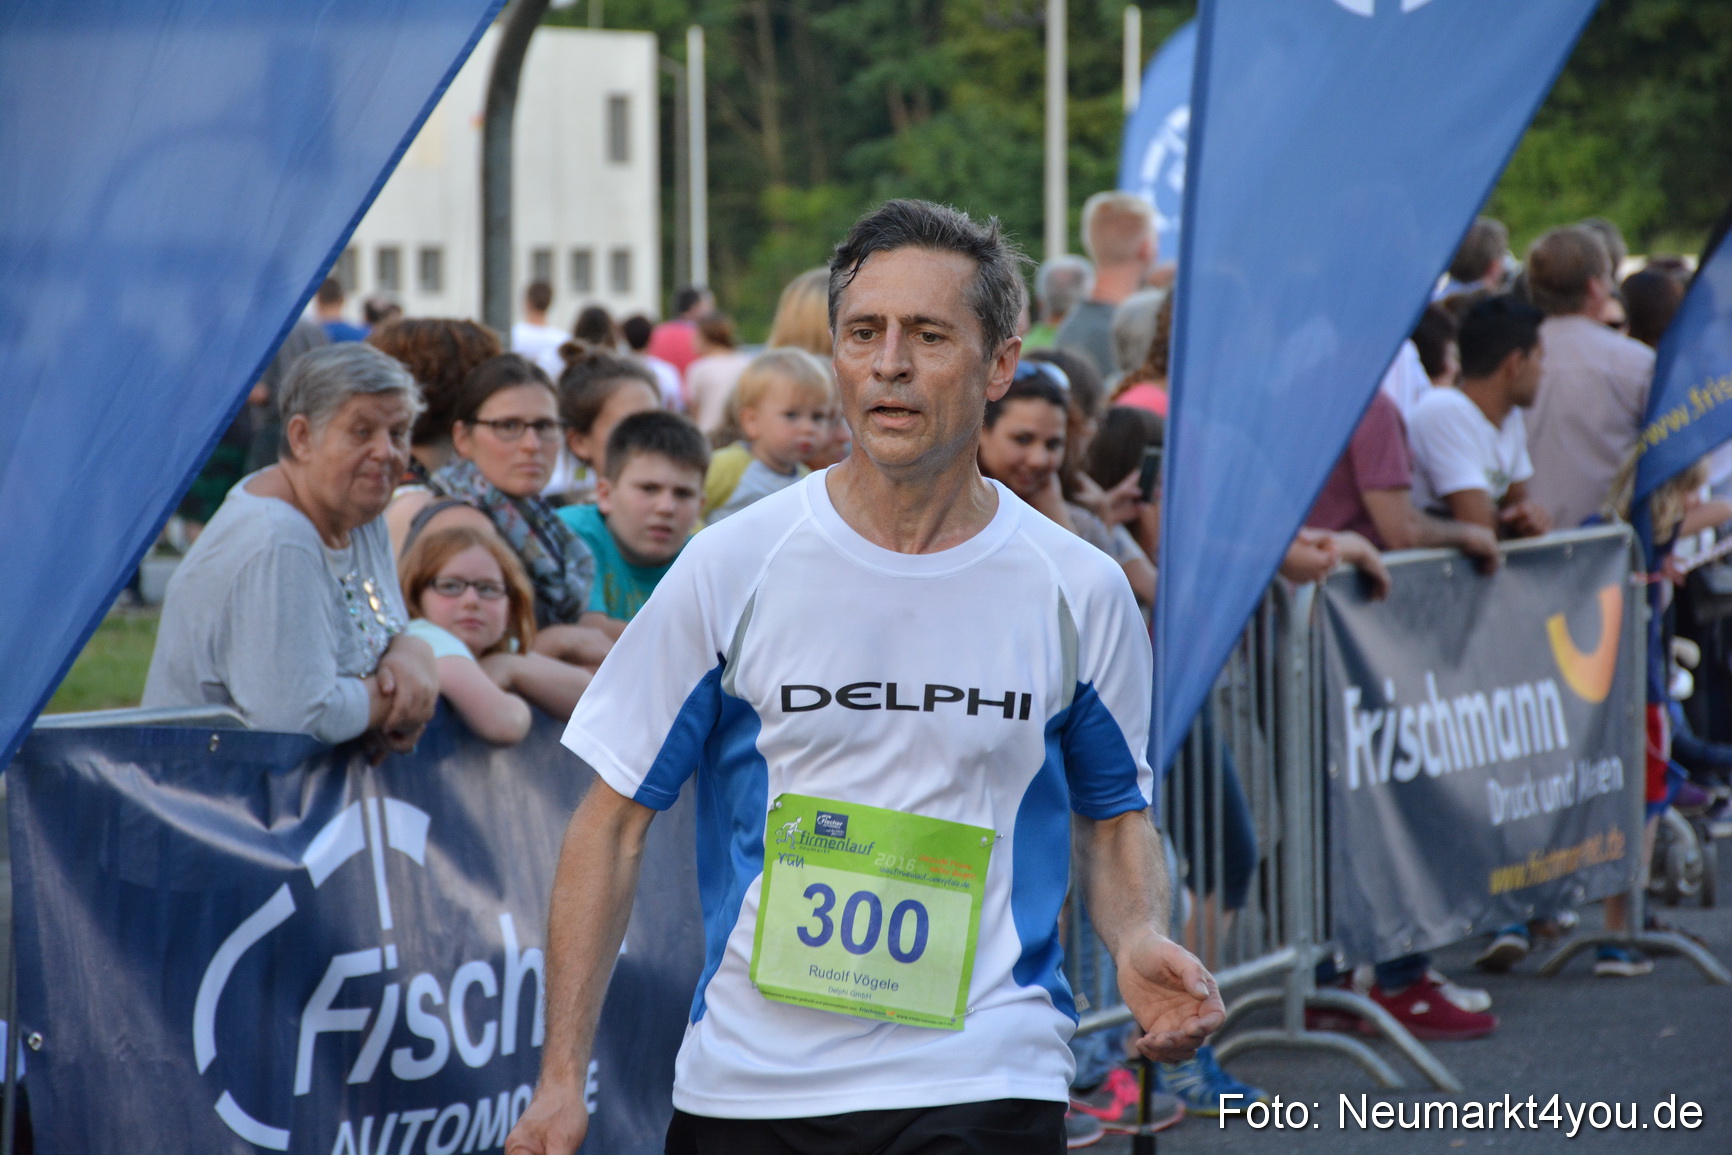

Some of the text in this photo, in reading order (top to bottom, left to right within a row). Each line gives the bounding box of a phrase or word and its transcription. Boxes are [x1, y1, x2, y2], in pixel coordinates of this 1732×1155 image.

[780, 681, 1032, 721] DELPHI
[1343, 671, 1569, 790] Frischmann
[800, 831, 876, 855] firmenlauf
[874, 853, 916, 871] 2016
[797, 883, 929, 964] 300
[809, 964, 899, 992] Rudolf Vögele
[828, 986, 871, 1000] Delphi GmbH
[293, 912, 546, 1097] Fisch
